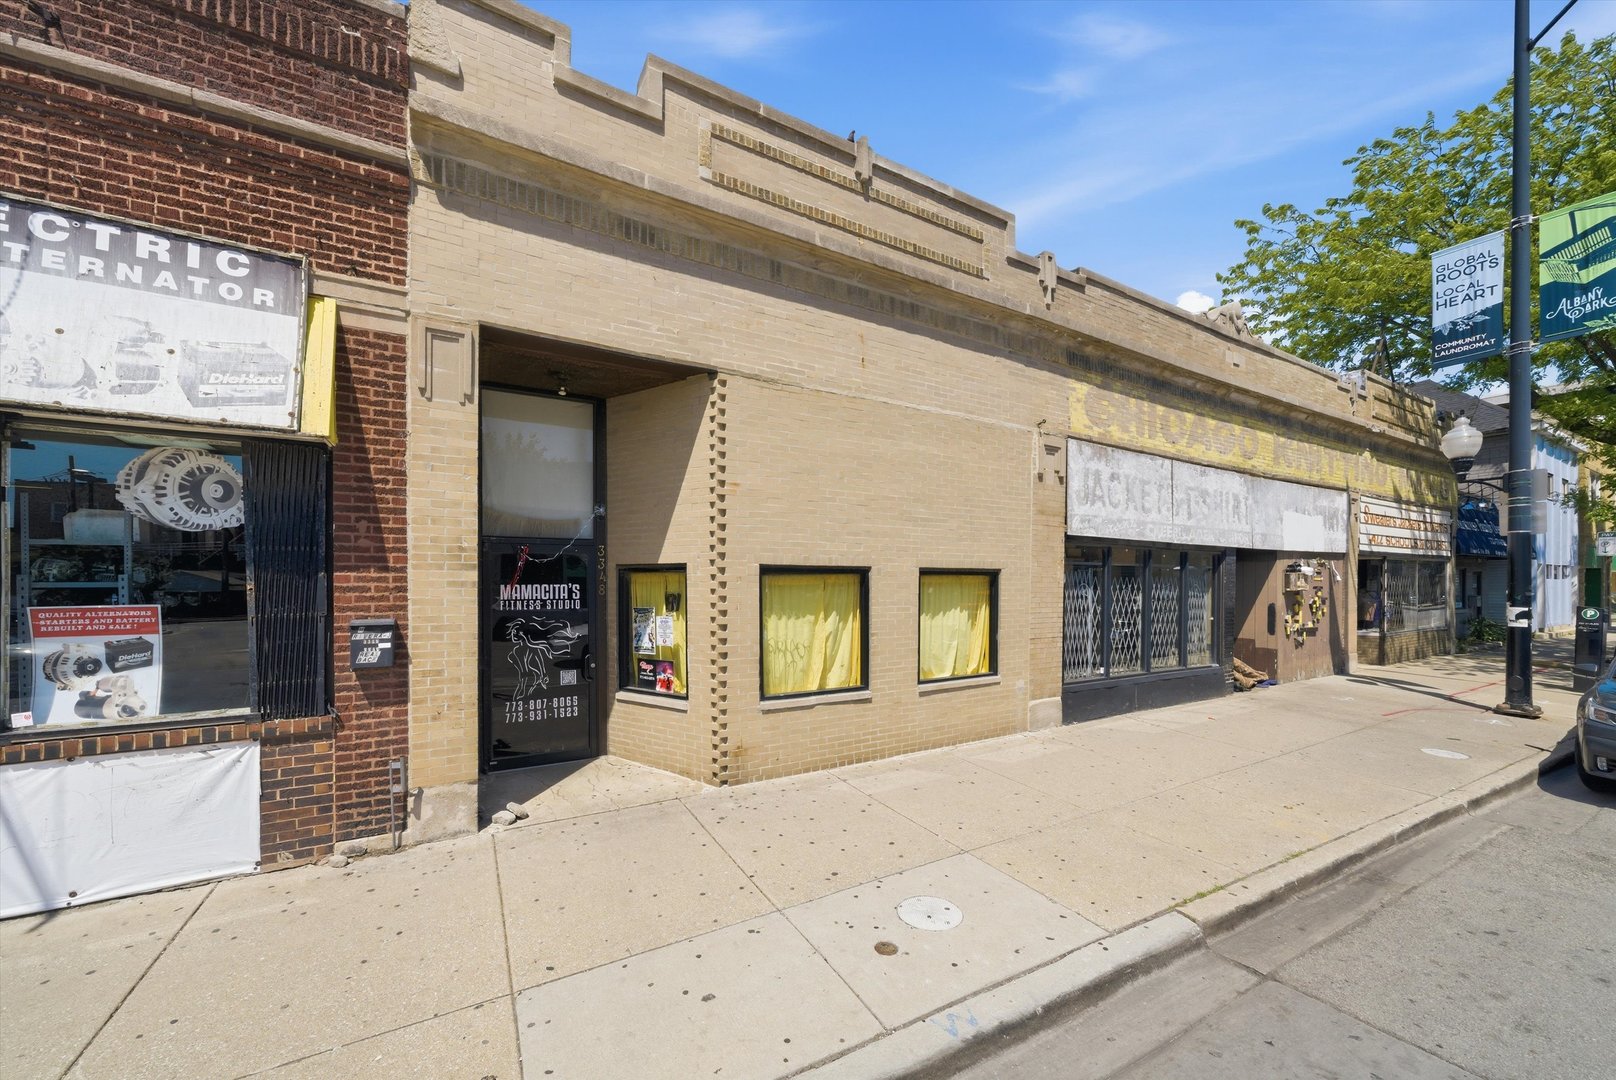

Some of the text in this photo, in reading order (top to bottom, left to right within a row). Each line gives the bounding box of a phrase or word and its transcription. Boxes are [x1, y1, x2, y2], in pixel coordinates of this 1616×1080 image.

[1436, 250, 1496, 274] GLOBAL
[3, 241, 274, 307] TERNATOR
[1436, 257, 1499, 285] ROOTS
[1436, 279, 1484, 300] LOCAL
[1436, 284, 1498, 311] HEART
[1567, 297, 1616, 323] PARK
[1434, 338, 1496, 358] LAUNDROMAT
[1435, 333, 1487, 350] COMMUNITY
[208, 373, 286, 386] DieHard
[500, 583, 580, 600] MAMACITA'S
[500, 599, 580, 610] FITNESS STUDIO
[1587, 610, 1595, 618] P
[118, 651, 151, 661] DieHard
[505, 696, 578, 712] 773-807-8065
[505, 706, 578, 723] 773-931-1523
